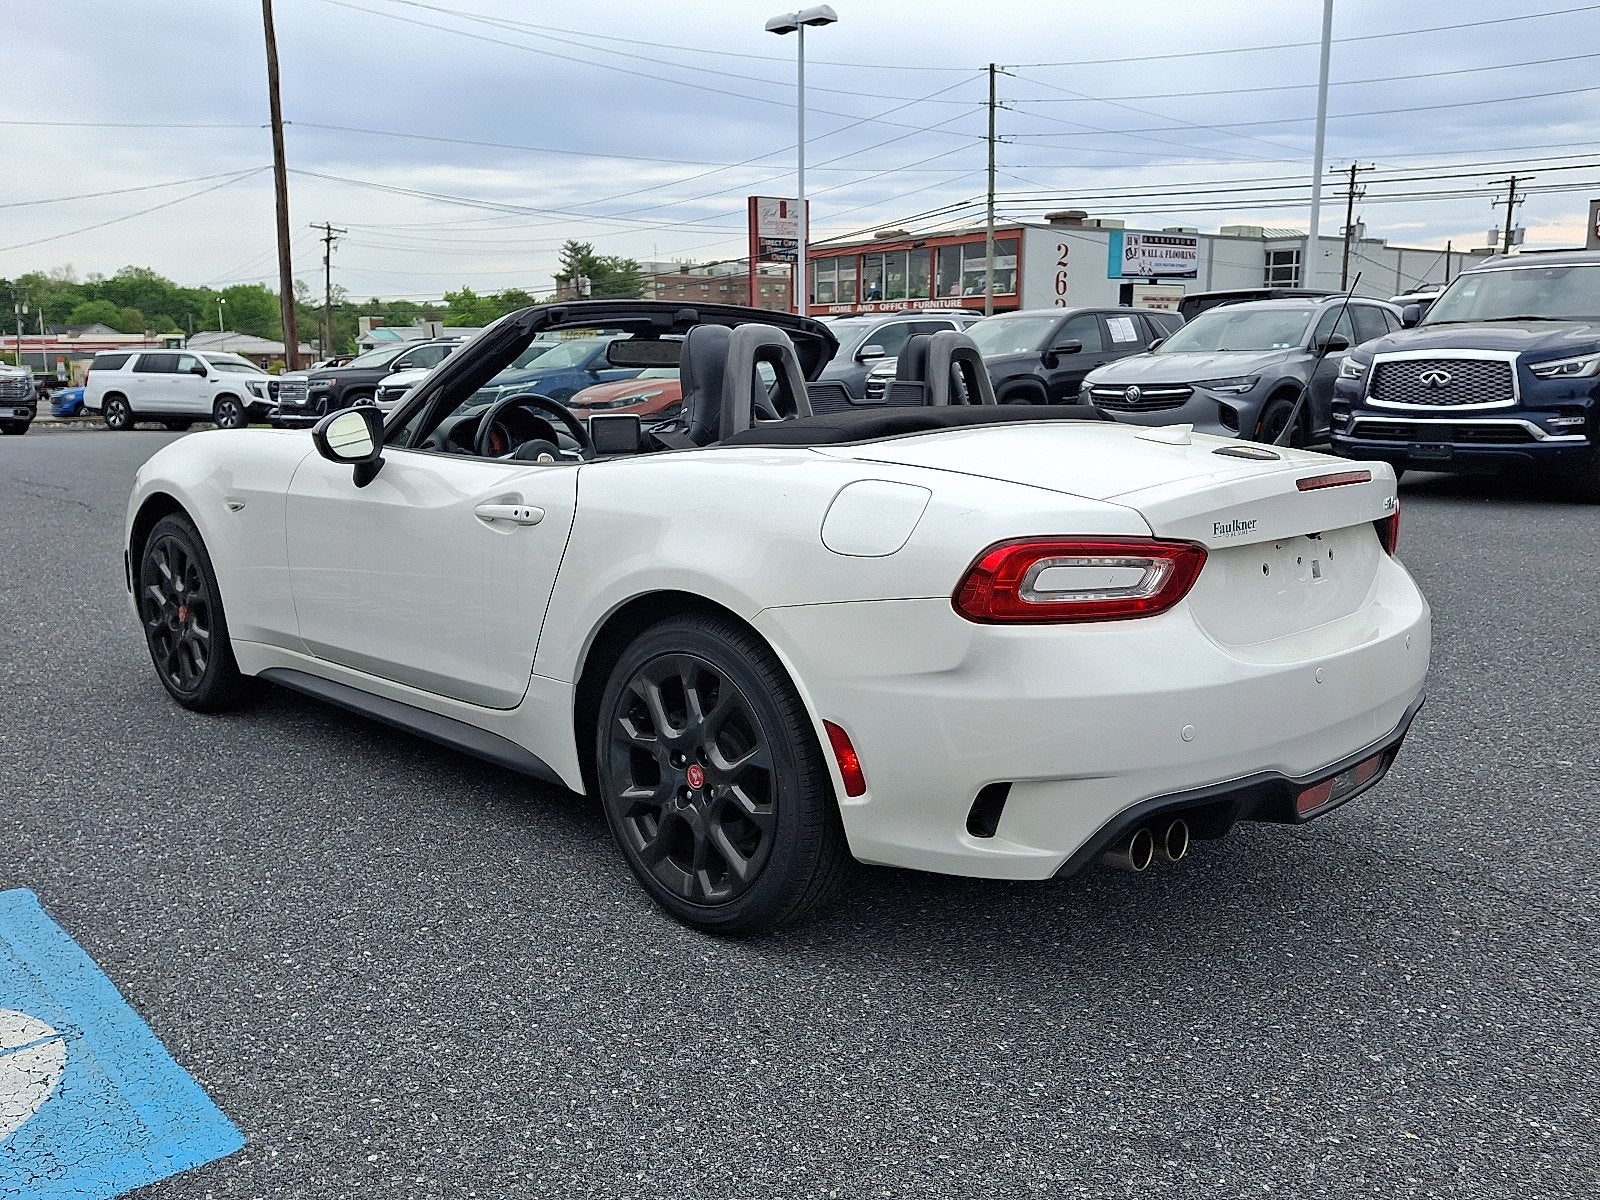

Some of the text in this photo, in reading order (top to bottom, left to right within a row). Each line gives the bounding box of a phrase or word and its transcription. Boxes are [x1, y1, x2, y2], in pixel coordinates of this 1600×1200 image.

[760, 238, 782, 247] DIRECT
[1142, 236, 1196, 246] HARRISBURG
[771, 253, 795, 261] OUTLET
[1141, 249, 1158, 258] WALL
[1165, 250, 1196, 260] FLOORING
[828, 299, 963, 313] HOME AND OFFICE FURNITURE
[1213, 519, 1258, 535] Faulkner
